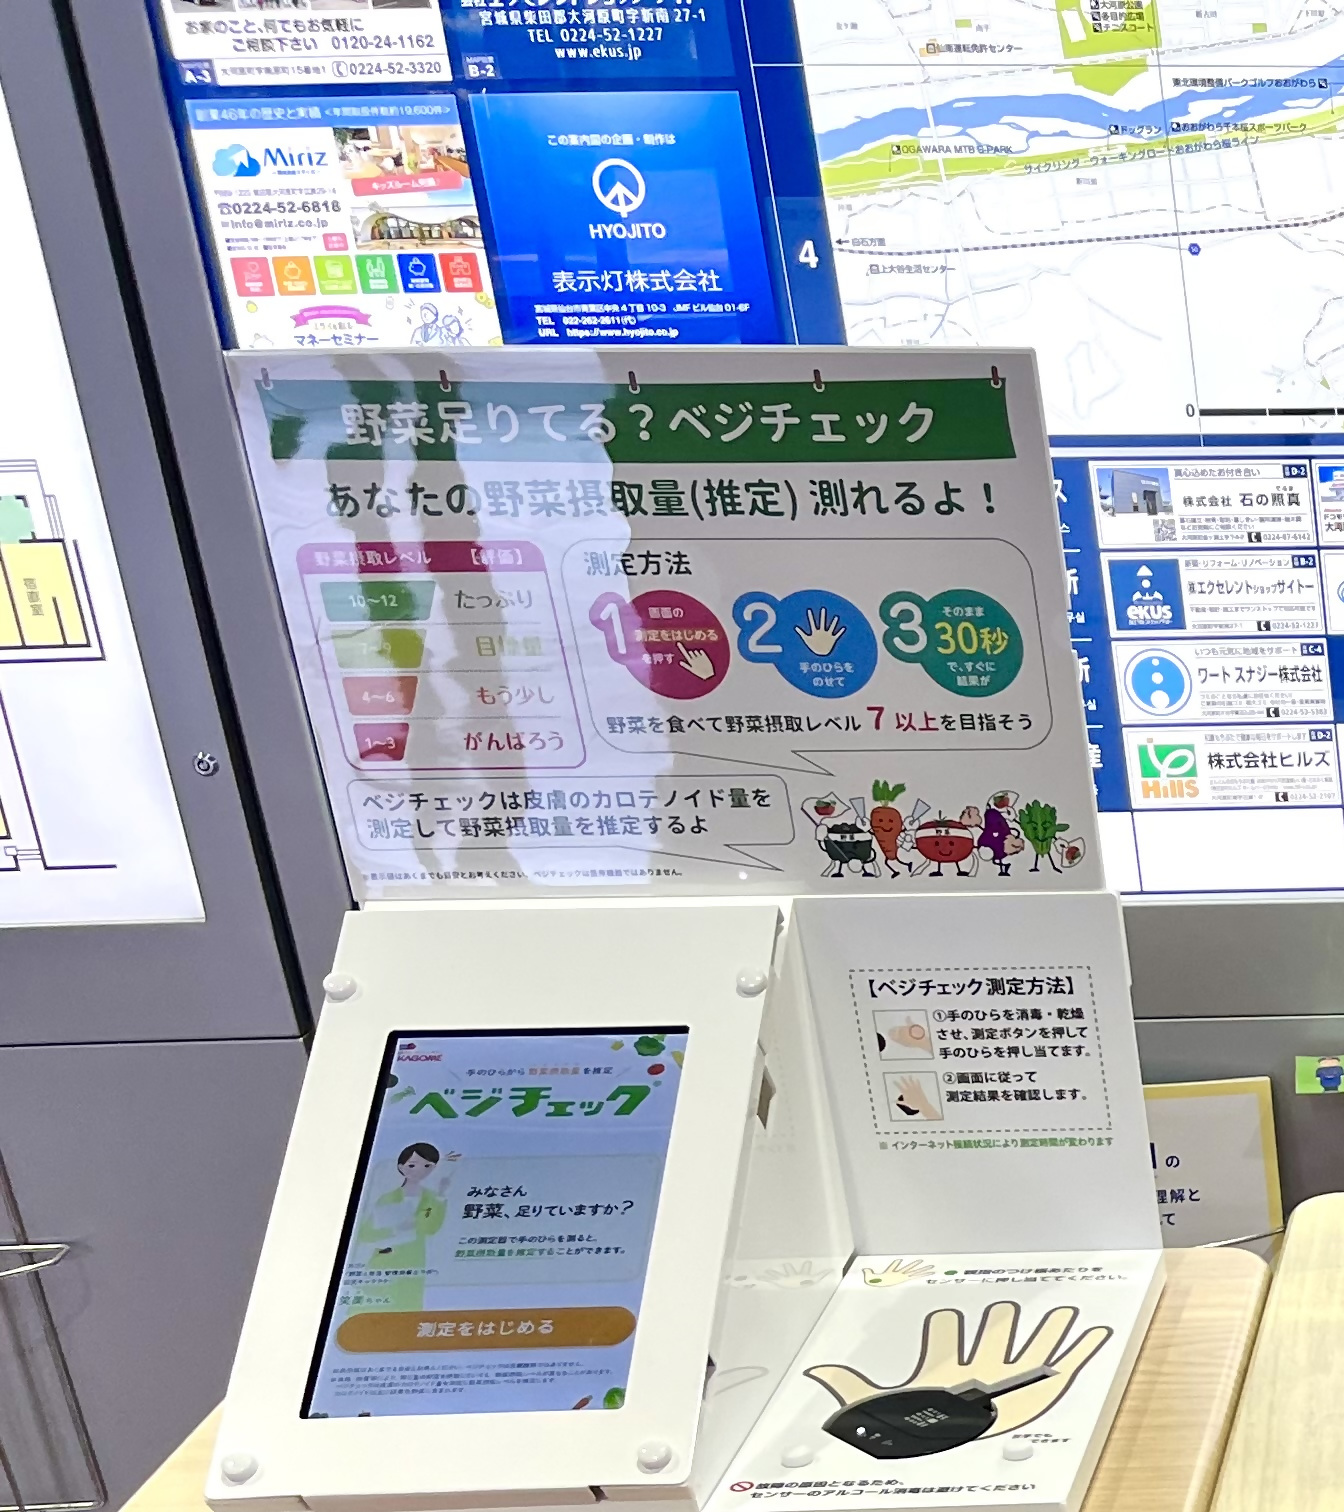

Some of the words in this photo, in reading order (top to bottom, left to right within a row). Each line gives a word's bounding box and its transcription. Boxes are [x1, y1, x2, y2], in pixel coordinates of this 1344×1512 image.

[674, 9, 706, 22] 27-1
[332, 35, 435, 49] 0120-24-1162
[528, 30, 553, 42] TEL
[561, 28, 662, 42] 0224-52-1227
[555, 46, 642, 60] www.ekus.jp
[350, 62, 441, 74] 0224-52-3320
[468, 65, 495, 77] B-2
[902, 145, 951, 153] OGAWARA
[264, 148, 328, 166] Miriz
[233, 201, 341, 214] 0224-52-6818
[589, 223, 666, 239] HYOJITO
[799, 240, 818, 268] 4
[552, 270, 722, 292] 表示灯株式会社
[293, 334, 378, 345] マネーセミナー
[340, 401, 935, 448] 野菜足りてる？ベジチェック
[1183, 496, 1232, 507] 株式会社
[584, 550, 692, 577] 測定方法
[454, 590, 533, 610] たっぷり
[942, 606, 985, 618] そのまま
[599, 603, 627, 655] 1
[743, 602, 783, 654] 2
[889, 601, 928, 653] 3
[634, 628, 718, 643] 測定をはじめる
[934, 621, 1010, 656] 30秒
[642, 653, 674, 665] を押す
[799, 662, 854, 674] 手のひらを
[947, 661, 996, 673] で、すぐに
[813, 676, 845, 688] のせて
[957, 675, 991, 687] 結果が
[477, 686, 555, 705] もう少し
[464, 732, 565, 752] がんばろう
[1207, 749, 1331, 771] 株式会社ヒルズ
[1141, 778, 1199, 799] Hills
[362, 787, 771, 811] ベジチェックは皮膚のカロテノイド量を
[367, 815, 709, 840] 測定して野菜摂取量を推定するよ
[868, 977, 1076, 998] 【ベジチェック測定方法】
[933, 1008, 1085, 1022] ①手のひらを消毒・乾燥
[937, 1026, 1088, 1041] させ、測定ボタンを押して
[939, 1045, 1091, 1059] 手のひらを押し当てます。
[943, 1071, 1037, 1085] ②画面に従って
[409, 1085, 651, 1119] ベジチェック
[946, 1088, 1087, 1103] 測定結果を確認します。
[466, 1185, 527, 1198] みなさん
[462, 1200, 634, 1220] 野菜、足りていますか？
[417, 1320, 555, 1337] 測定をはじめる
